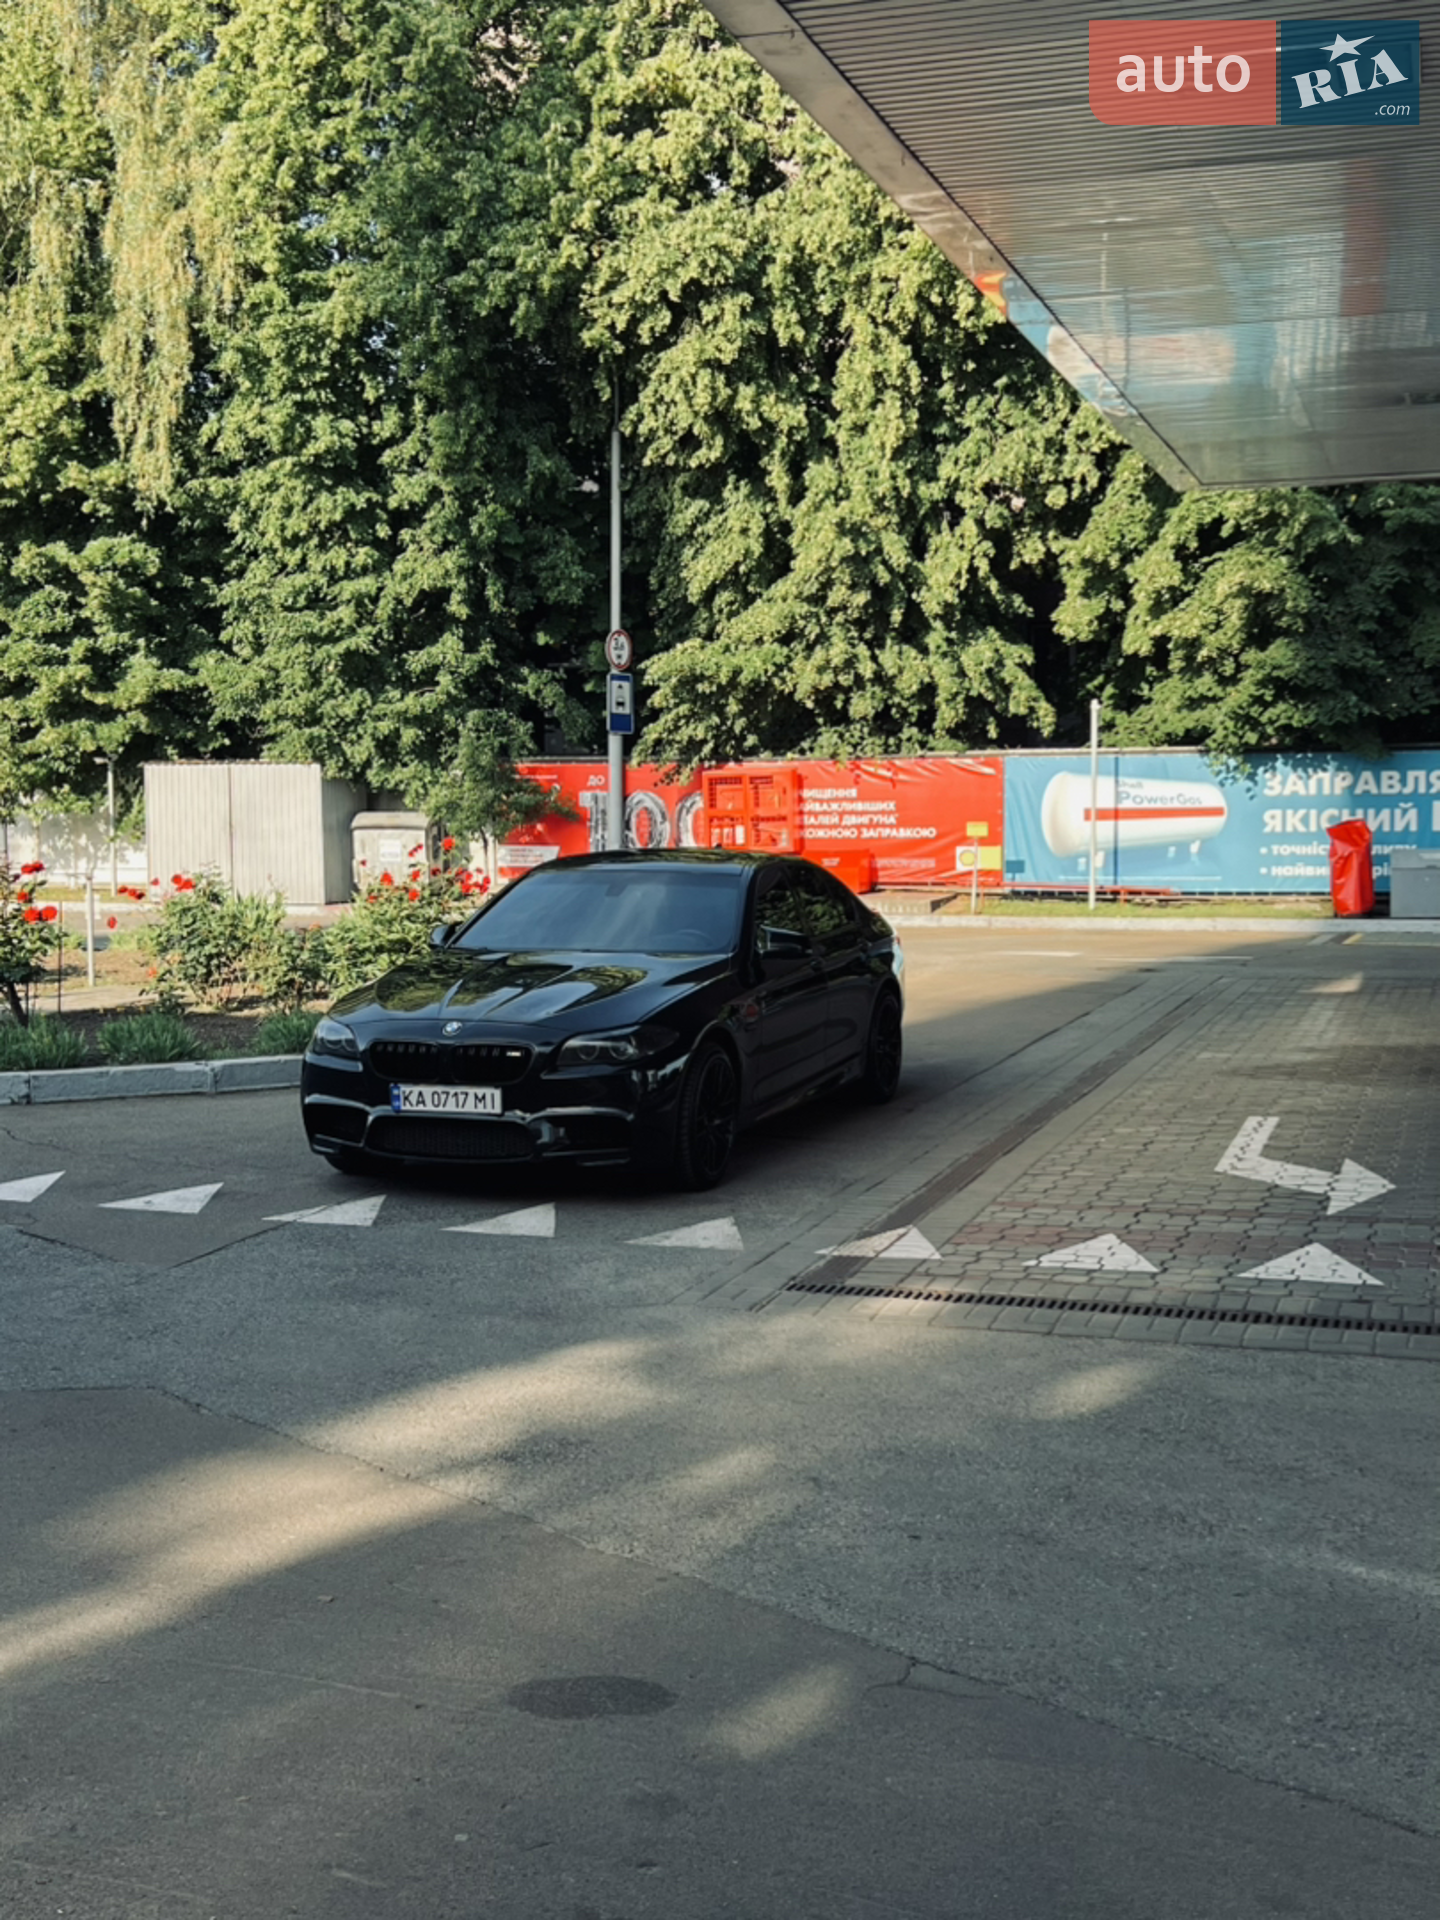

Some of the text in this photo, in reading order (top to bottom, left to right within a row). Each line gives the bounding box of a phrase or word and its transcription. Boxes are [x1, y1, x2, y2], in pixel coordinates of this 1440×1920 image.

[801, 827, 858, 840] ОЖНОЮ
[1271, 840, 1331, 856] точніс
[1271, 862, 1331, 877] найви
[402, 1089, 496, 1111] KA 0717 MI
